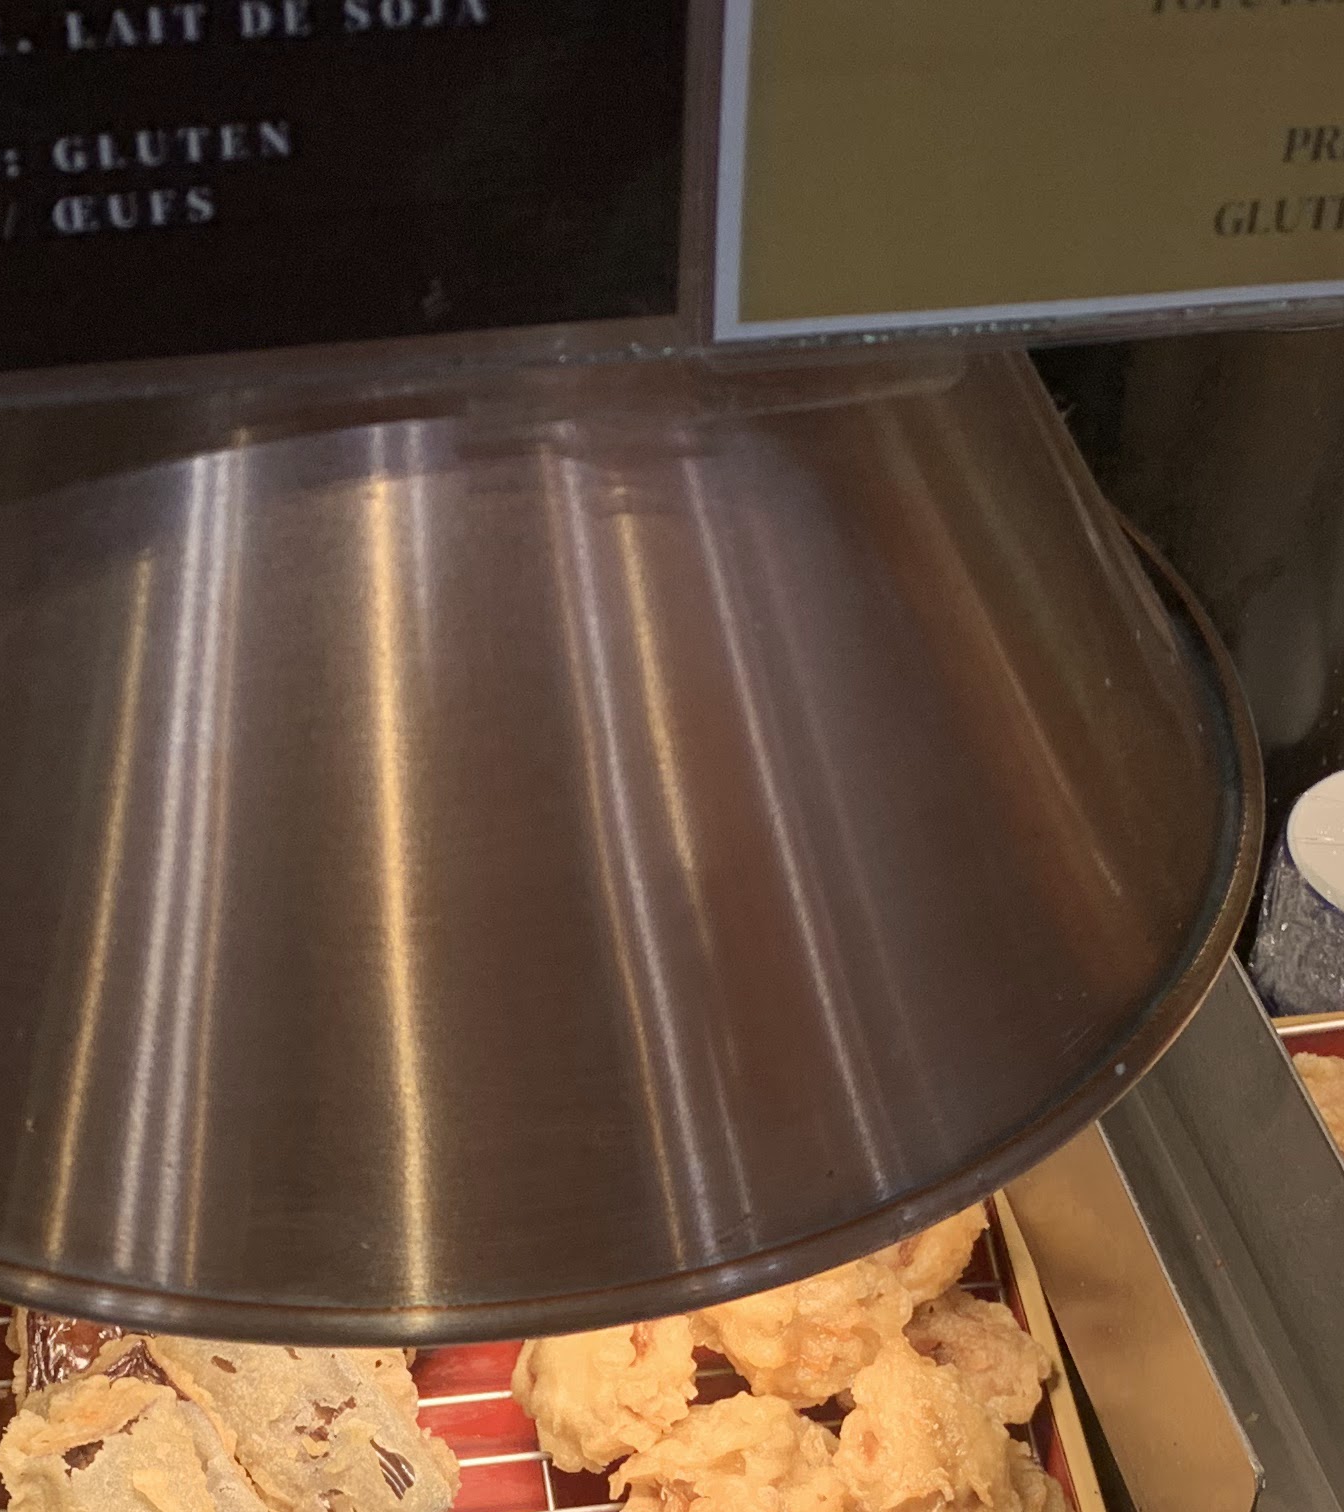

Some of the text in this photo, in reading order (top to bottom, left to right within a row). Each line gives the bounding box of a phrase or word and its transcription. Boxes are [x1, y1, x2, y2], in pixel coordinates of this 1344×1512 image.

[65, 3, 207, 51] LAIT
[238, 0, 312, 40] DE
[343, 0, 490, 34] SOJA
[52, 120, 293, 174] GLUTEN
[52, 187, 216, 236] ŒUFS
